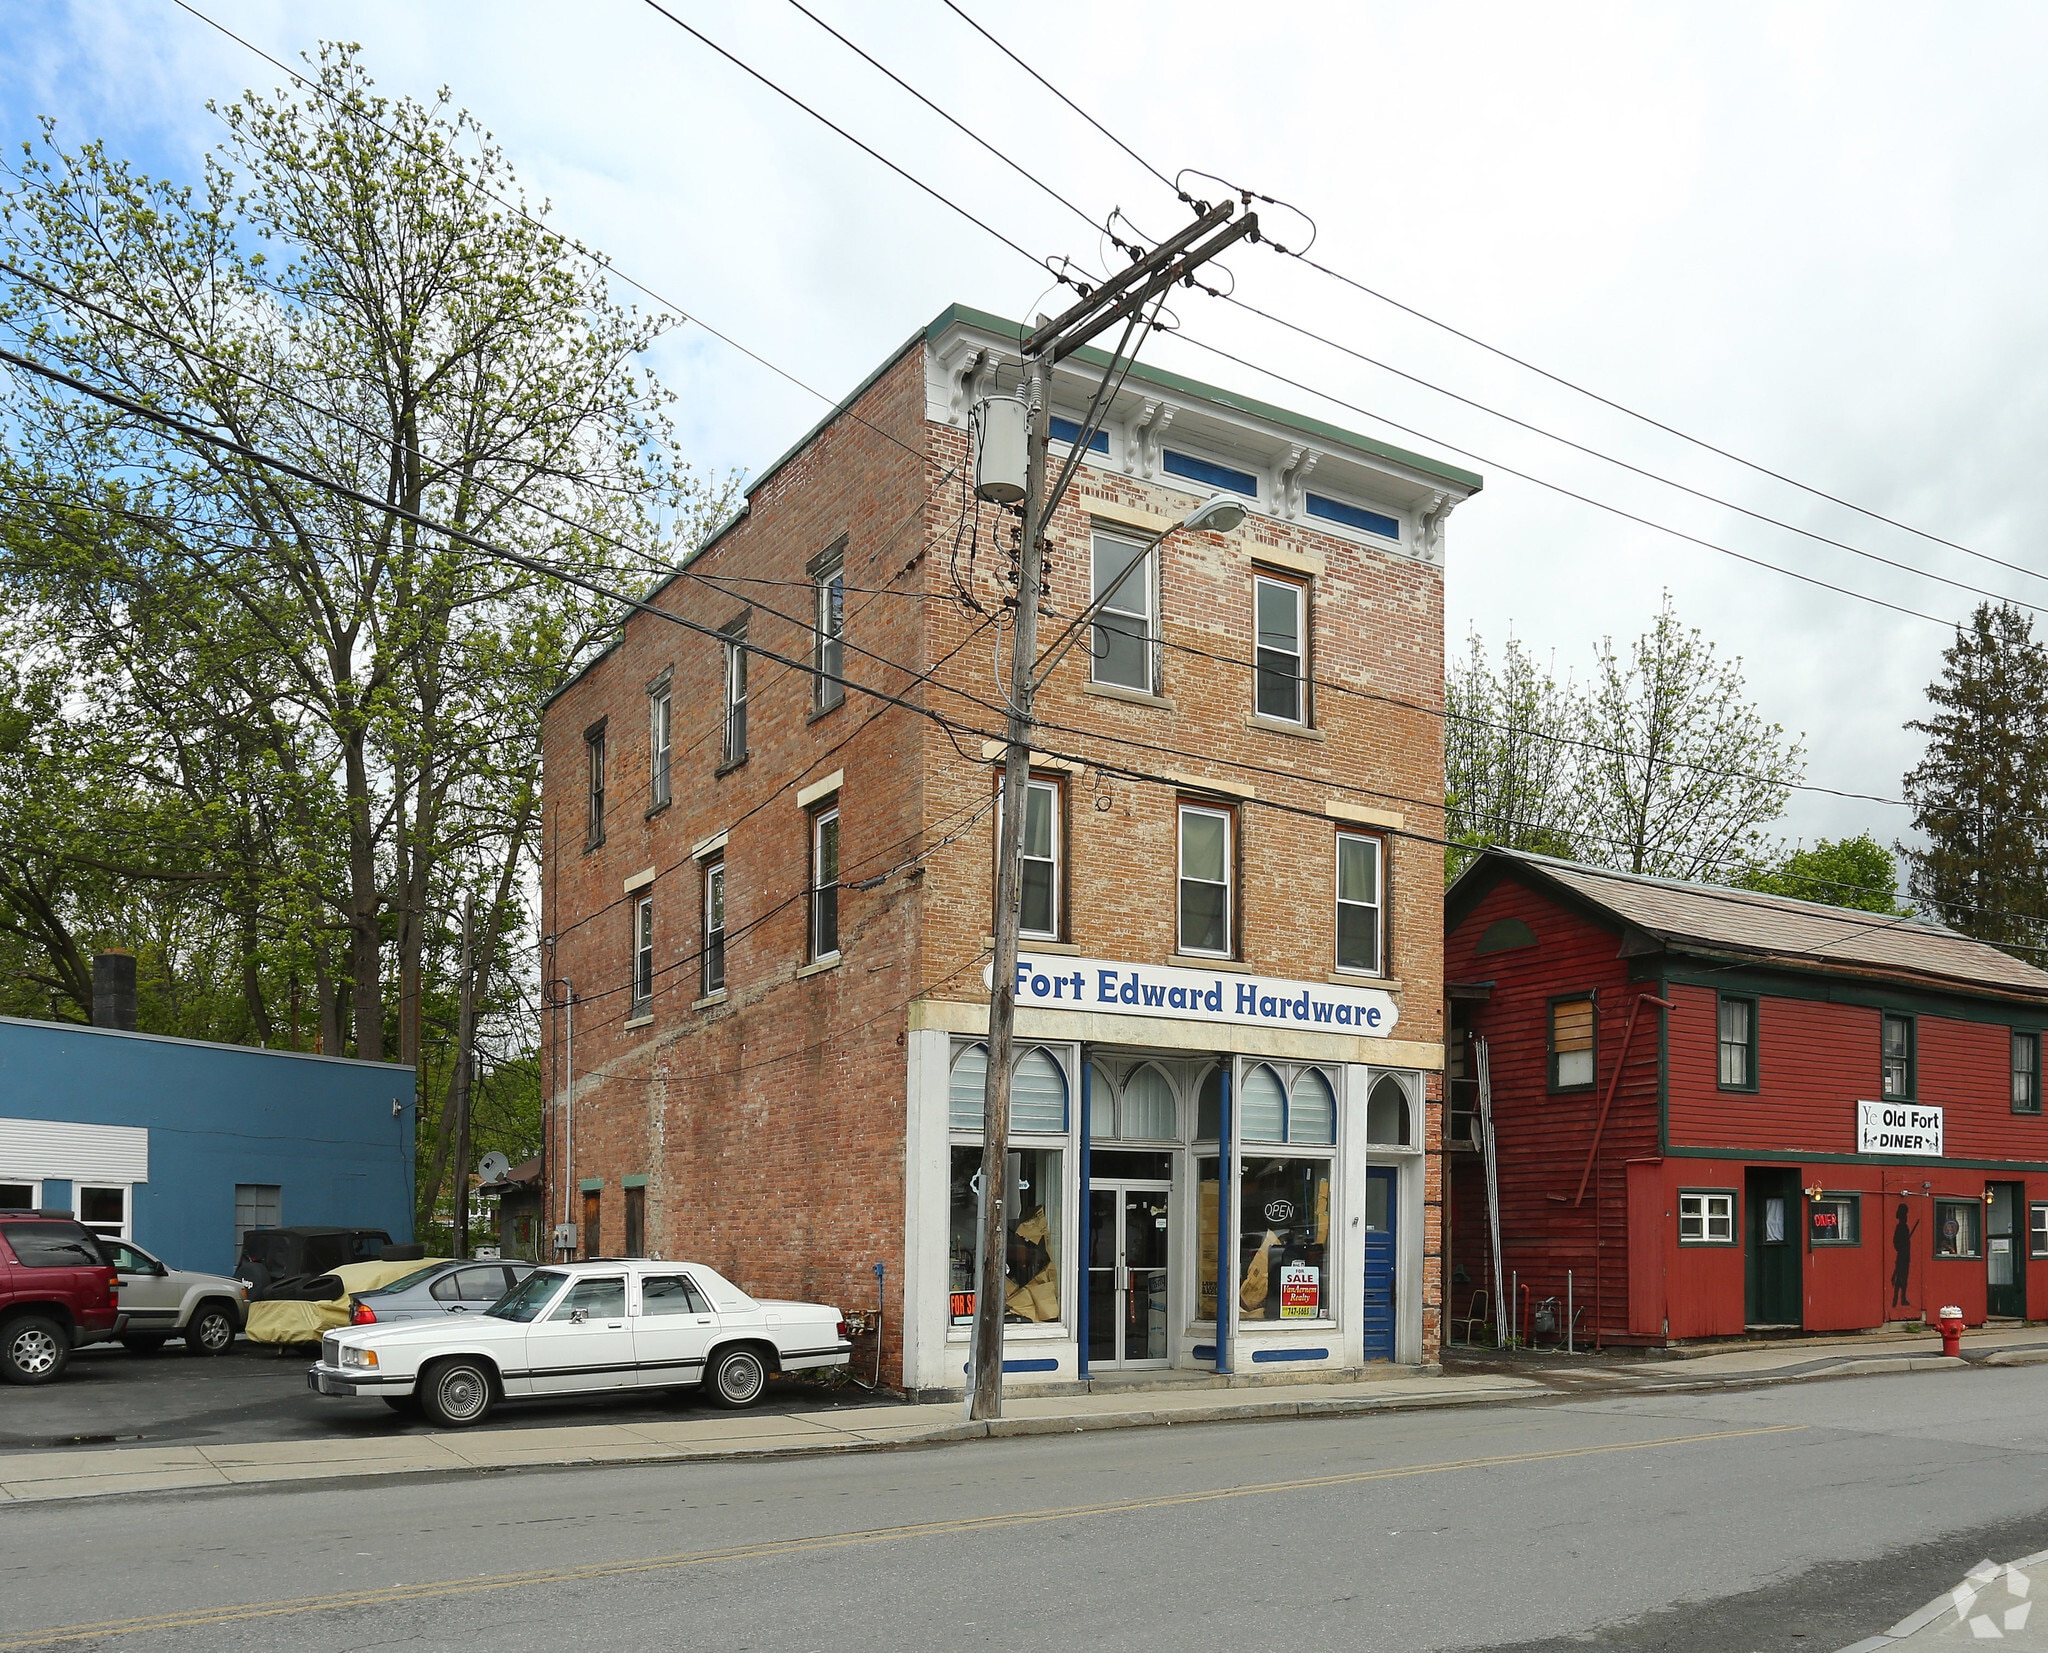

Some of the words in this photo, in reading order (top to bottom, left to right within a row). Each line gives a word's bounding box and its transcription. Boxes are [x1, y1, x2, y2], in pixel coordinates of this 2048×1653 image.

[1015, 962, 1086, 1000] Fort
[1097, 969, 1223, 1013] Edward
[1235, 983, 1381, 1028] Hardware
[1863, 1105, 1878, 1126] Ye
[1883, 1109, 1906, 1127] Old
[1911, 1112, 1939, 1129] Fort
[1880, 1134, 1923, 1149] DINER
[1264, 1203, 1295, 1218] OPEN
[1286, 1274, 1314, 1283] SALE
[951, 1295, 965, 1315] FOR
[967, 1294, 976, 1314] SA
[1290, 1293, 1311, 1303] Realty
